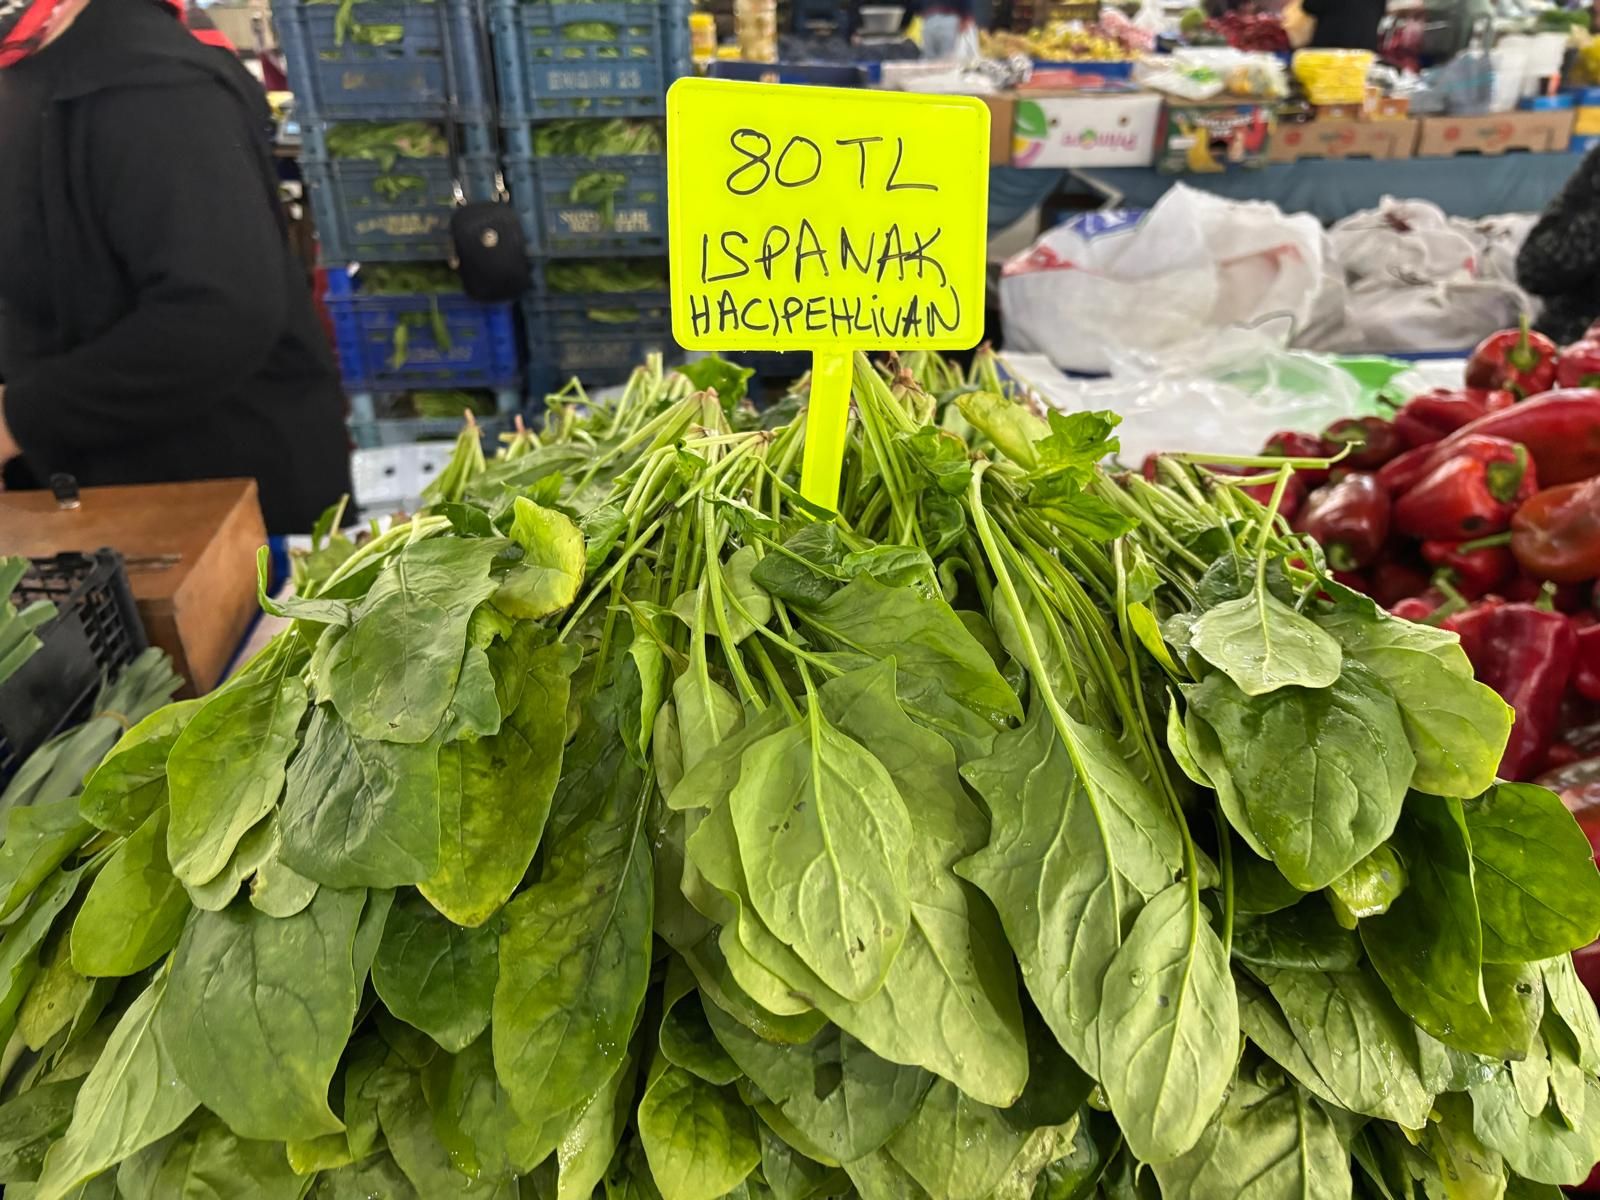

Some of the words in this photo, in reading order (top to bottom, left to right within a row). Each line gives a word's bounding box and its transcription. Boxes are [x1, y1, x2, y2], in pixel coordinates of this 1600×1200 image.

[726, 128, 822, 196] 80
[836, 136, 939, 192] TL
[701, 218, 947, 288] ISPANAK
